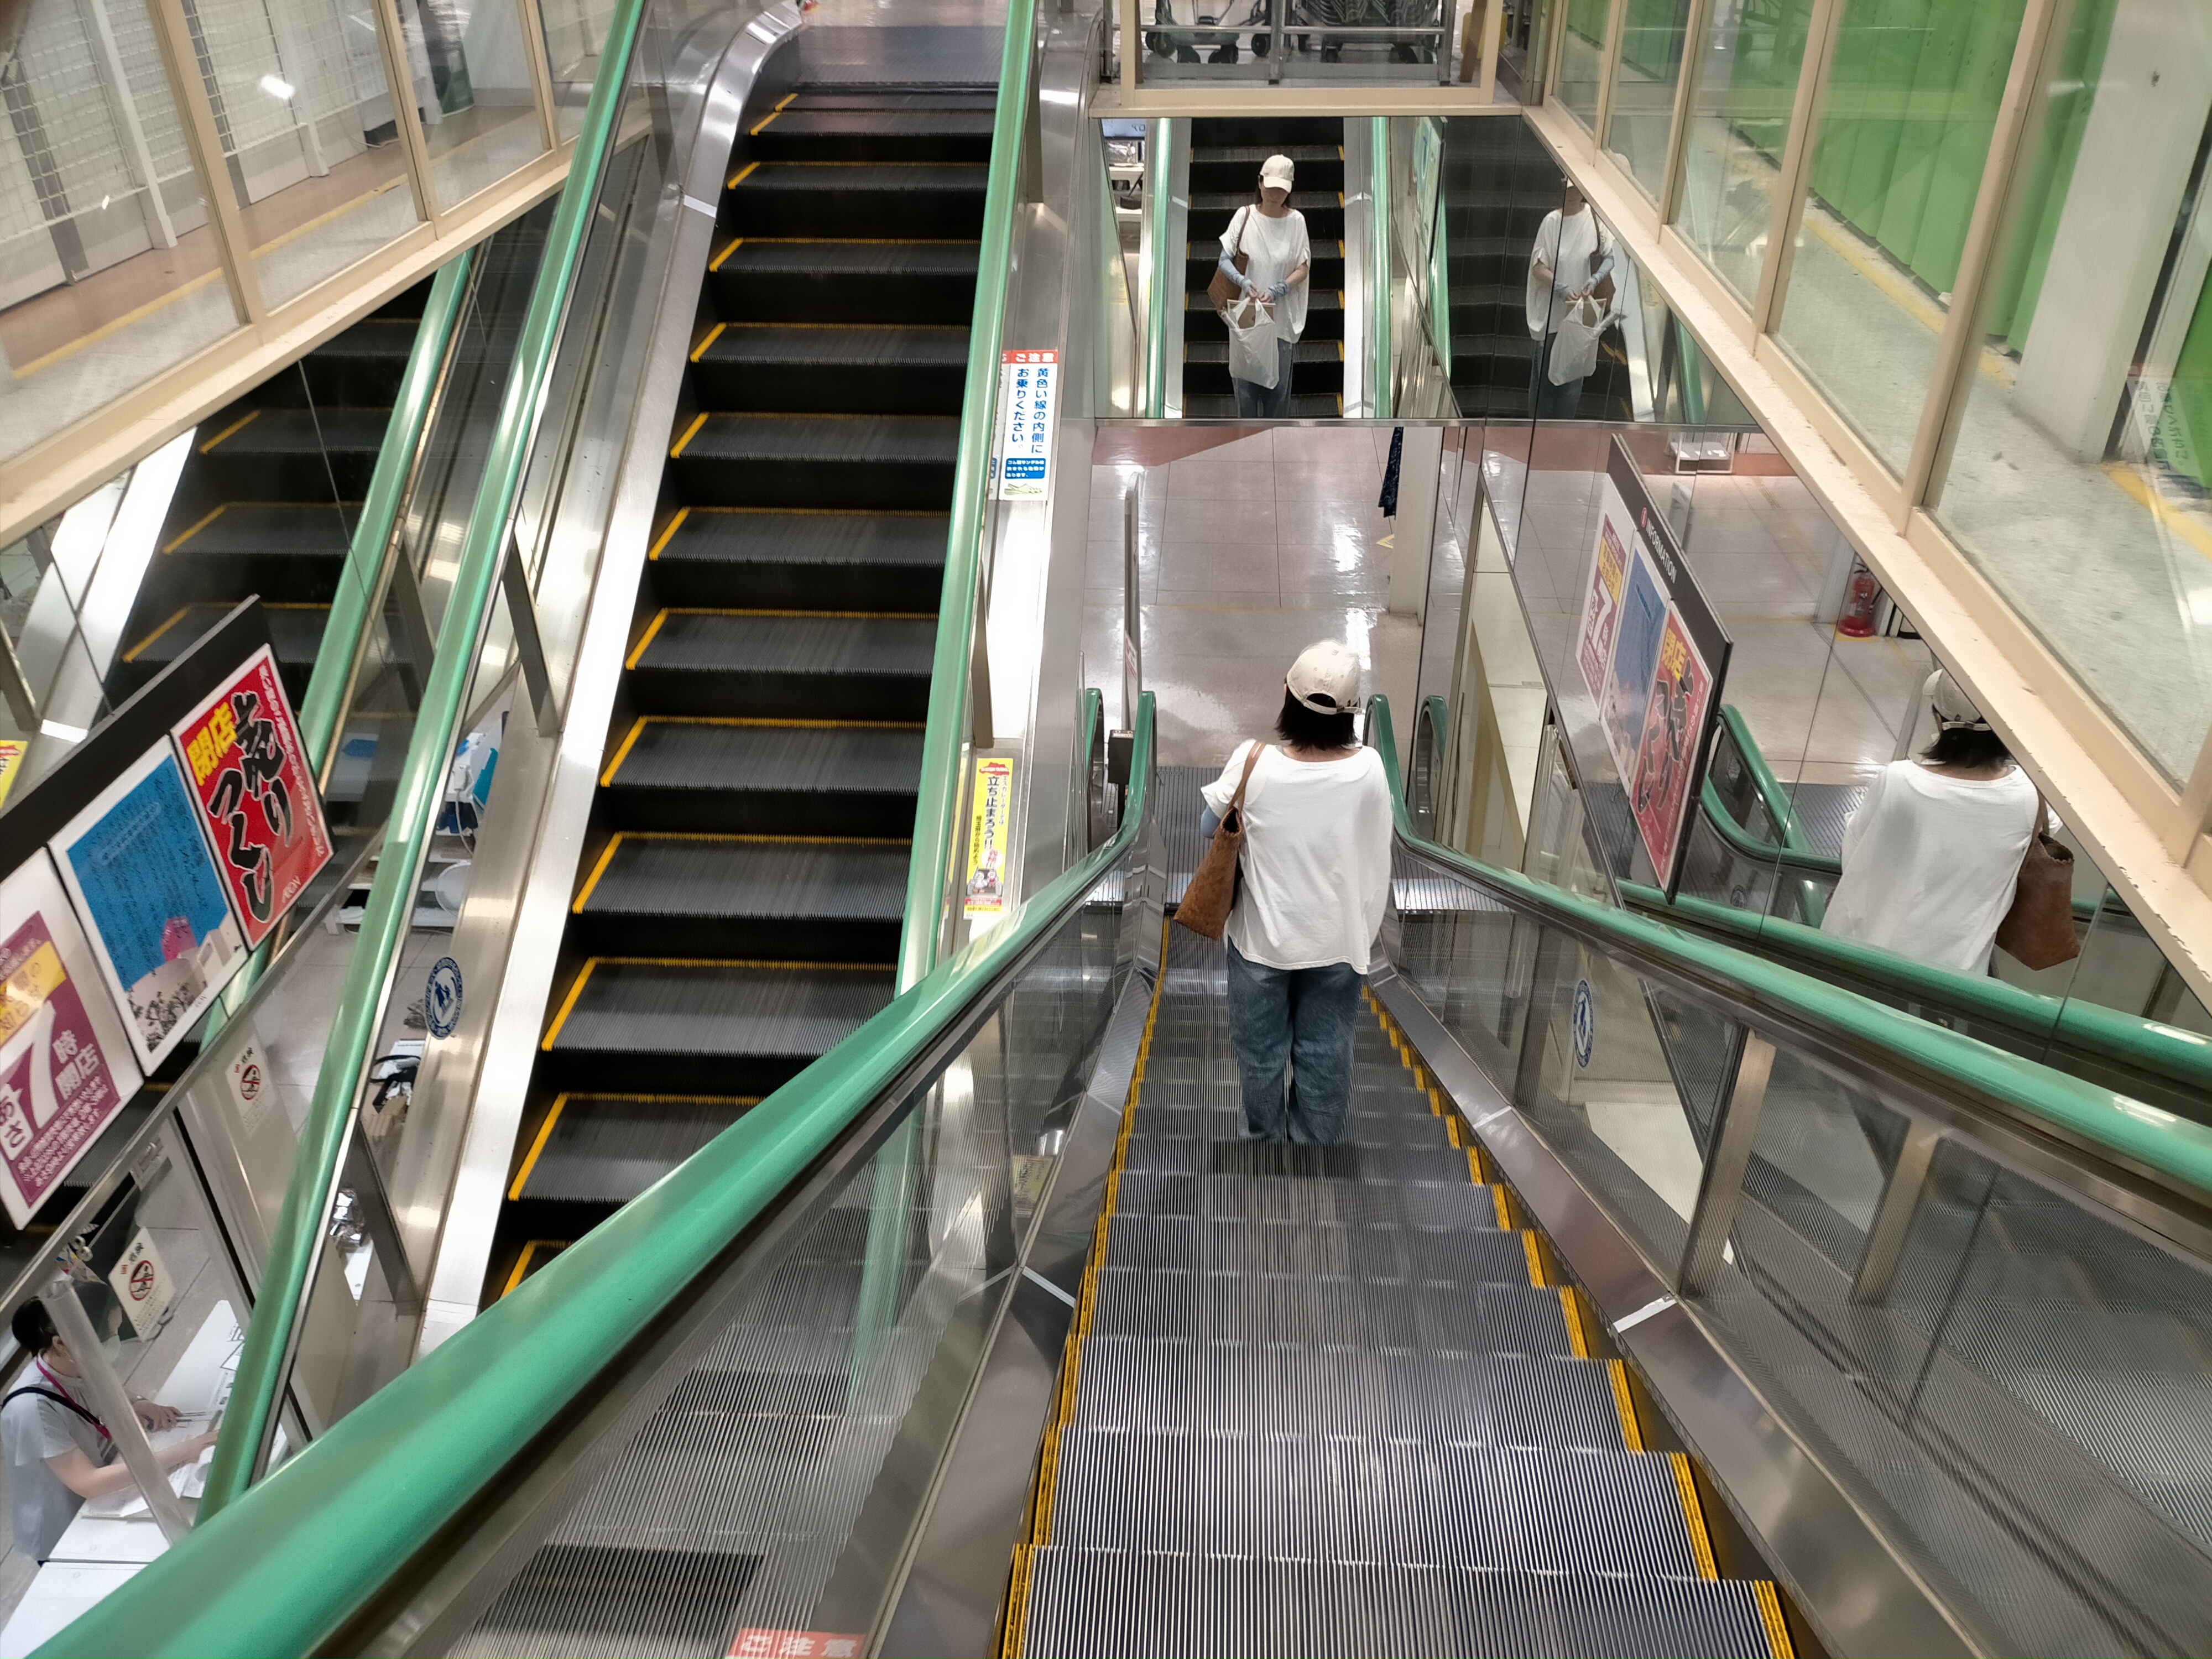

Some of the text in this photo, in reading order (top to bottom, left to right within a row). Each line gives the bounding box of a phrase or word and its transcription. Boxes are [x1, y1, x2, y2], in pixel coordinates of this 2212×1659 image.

[1015, 352, 1054, 362] ご注意
[1011, 368, 1029, 448] お乗りください。
[1031, 368, 1049, 453] 黄色い線の内側に
[1646, 518, 1677, 583] INFORMATION
[187, 701, 237, 786] 閉店
[52, 1029, 78, 1064] 時
[55, 1043, 100, 1100] 開店
[741, 1634, 857, 1658] ご注意
